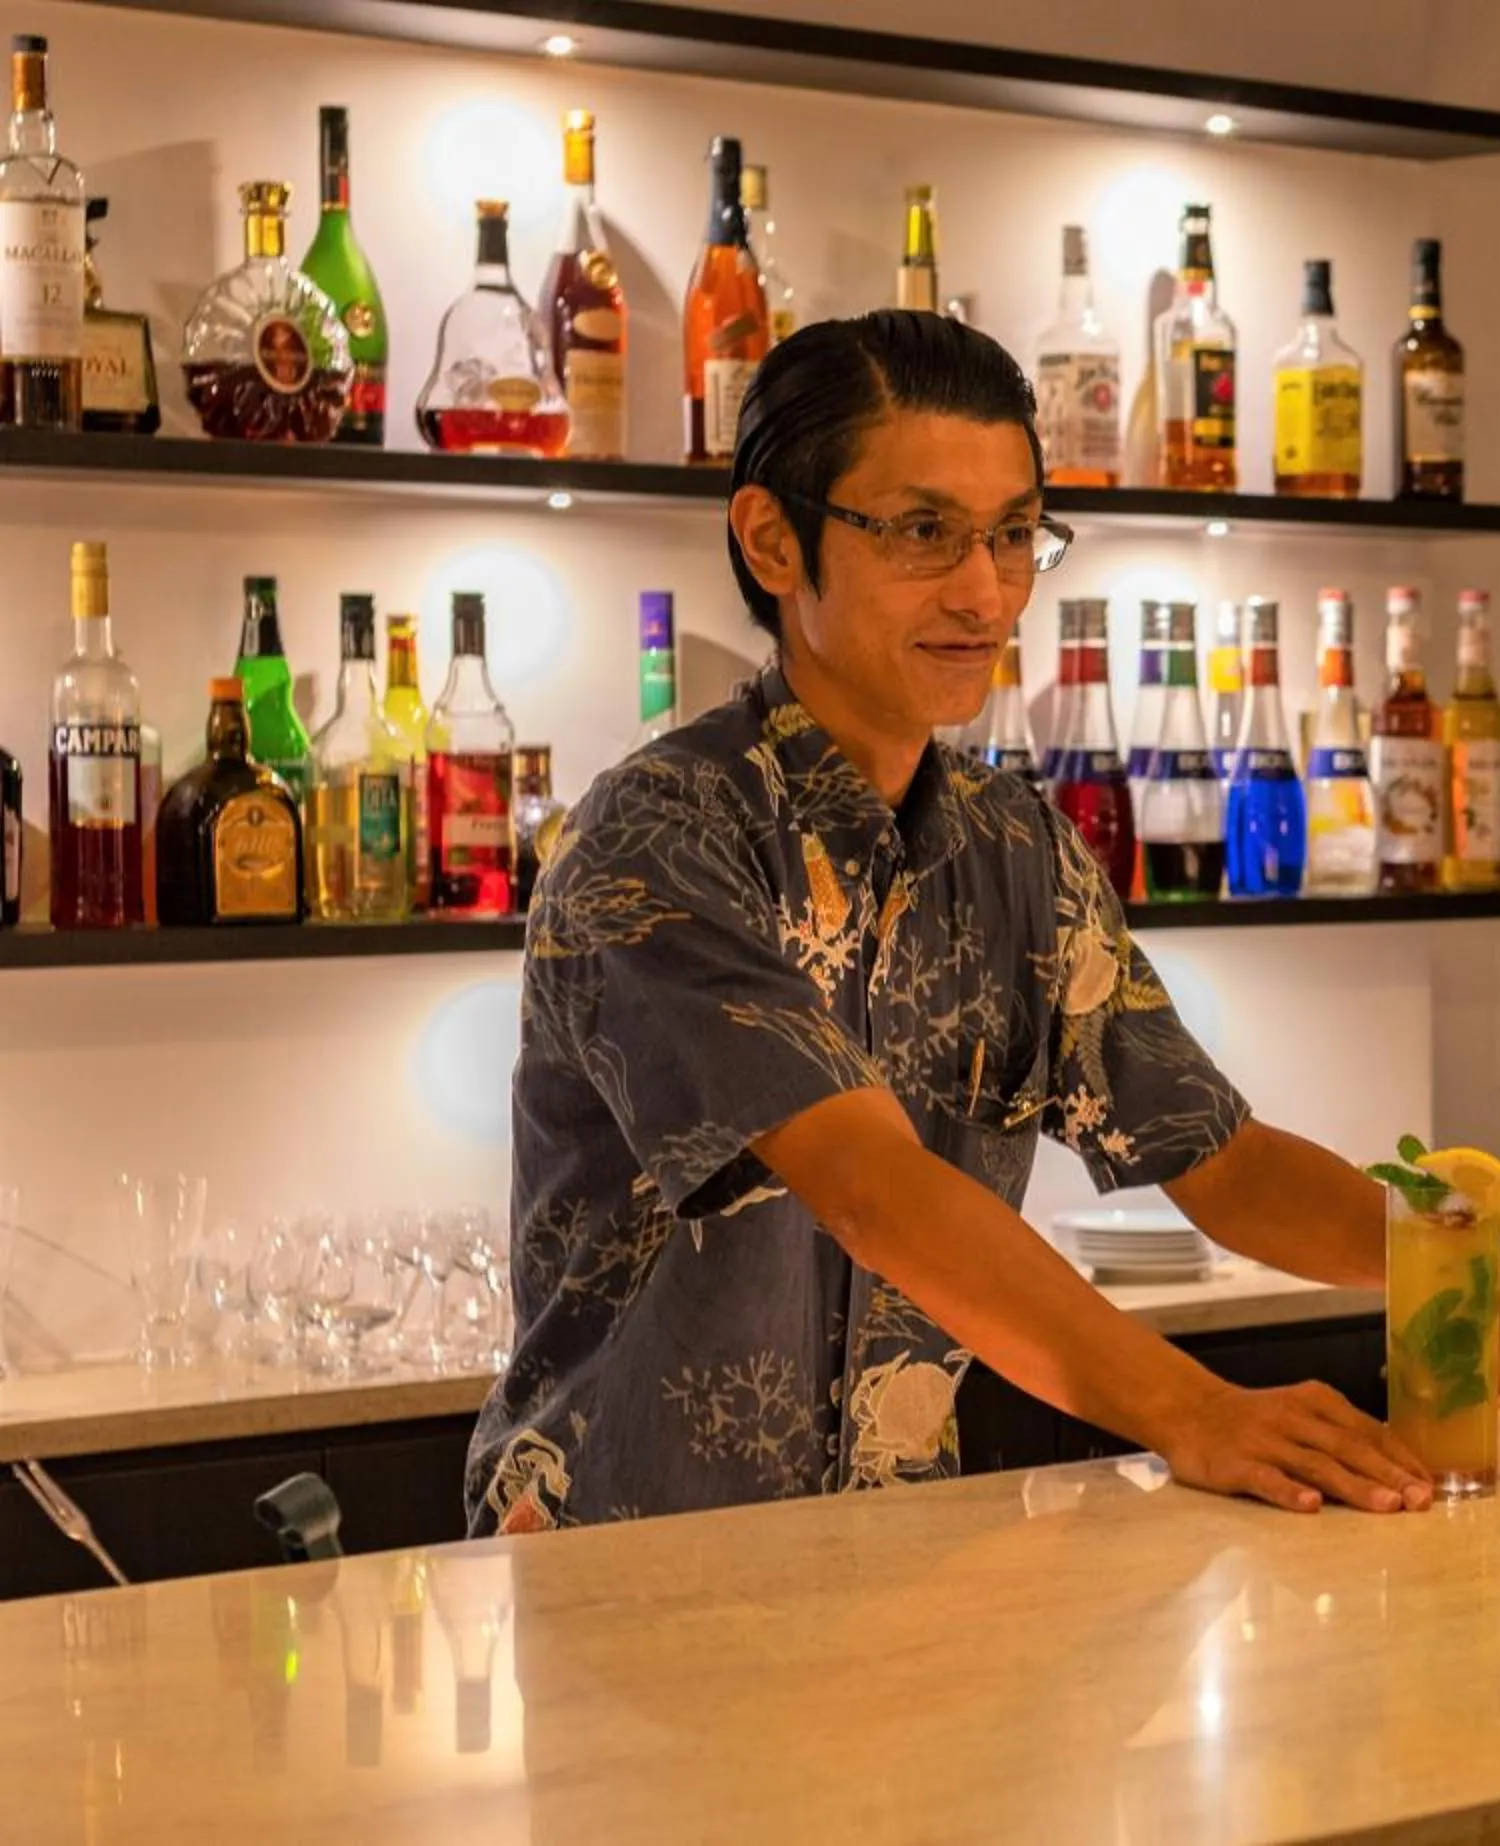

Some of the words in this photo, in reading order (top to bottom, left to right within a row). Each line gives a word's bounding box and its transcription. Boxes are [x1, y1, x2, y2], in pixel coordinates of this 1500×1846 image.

[5, 245, 83, 264] MACALLA
[43, 282, 62, 305] 12
[55, 726, 138, 754] CAMPAR
